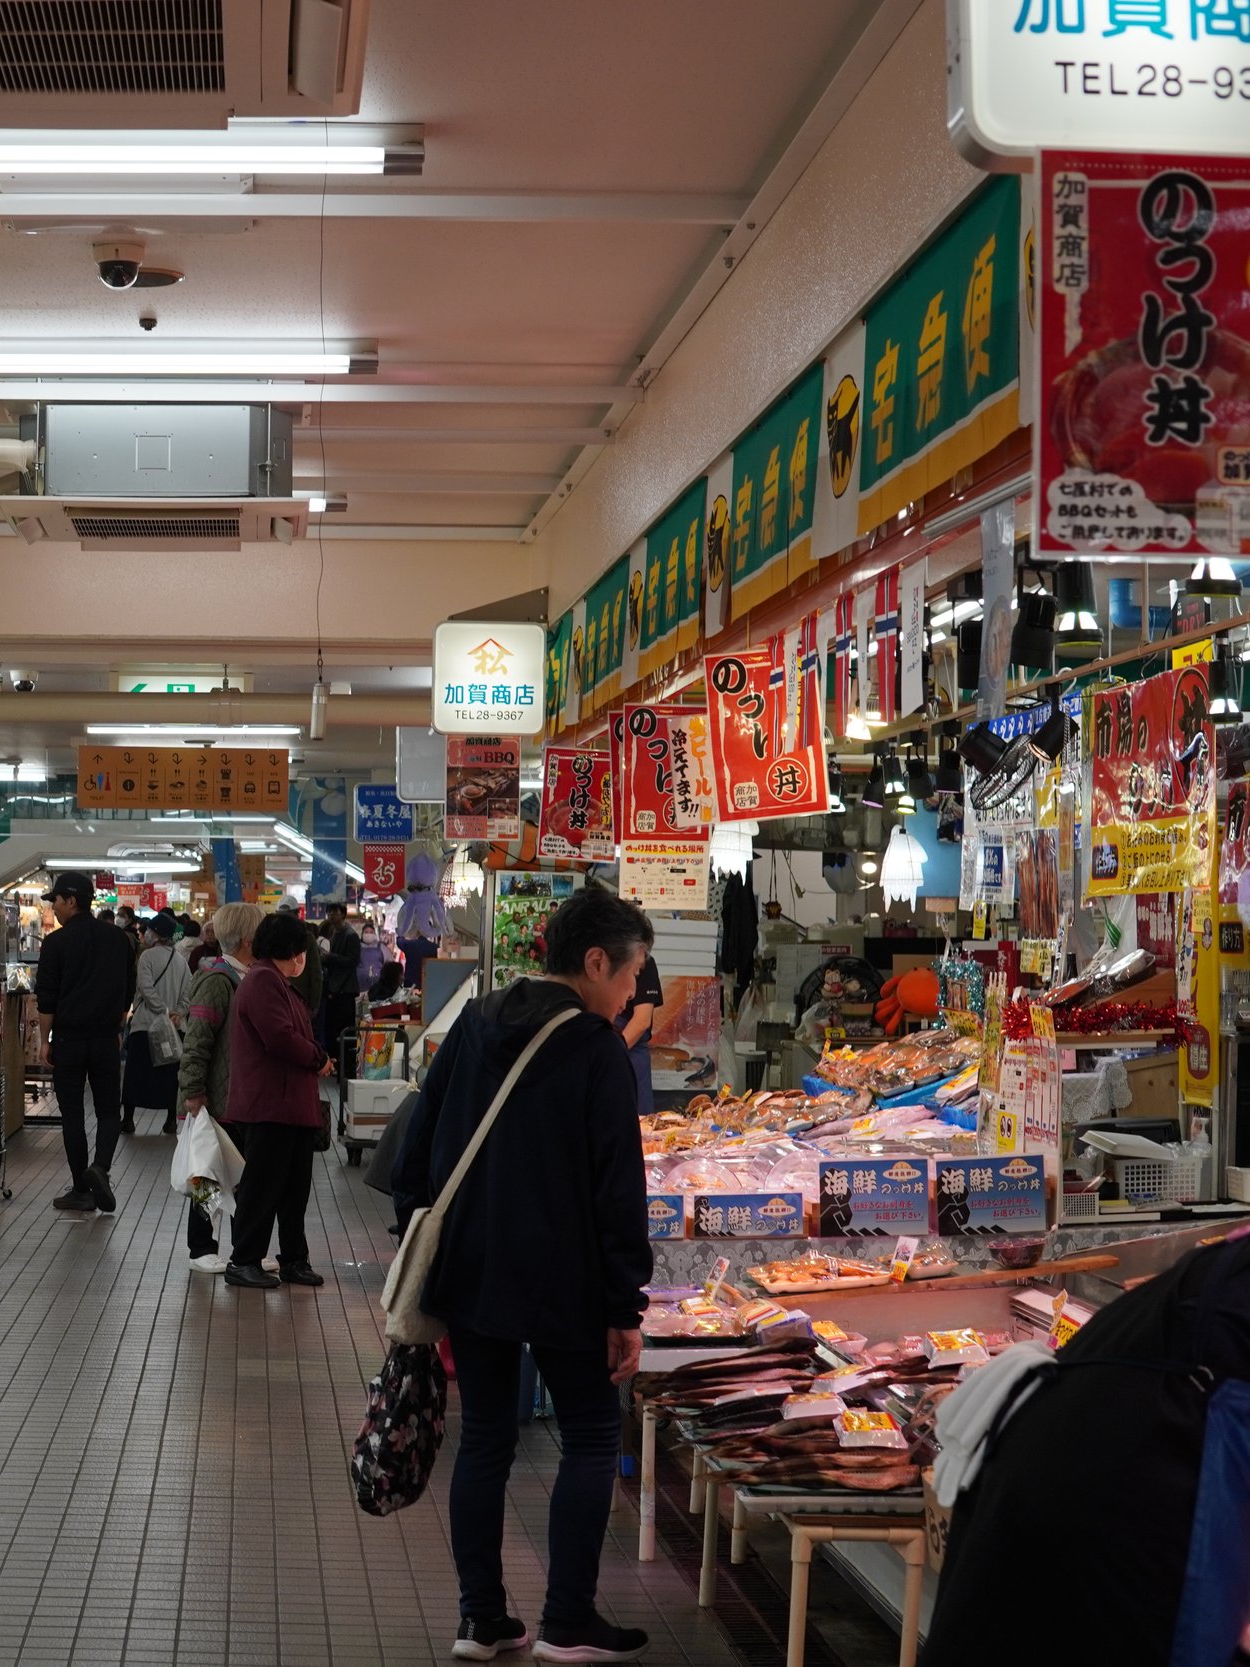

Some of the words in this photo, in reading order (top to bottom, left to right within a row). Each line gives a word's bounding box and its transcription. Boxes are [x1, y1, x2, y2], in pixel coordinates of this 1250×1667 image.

[1054, 174, 1087, 288] 加賀商店
[1140, 171, 1216, 444] のっけ丼
[872, 234, 996, 464] 宅急便
[734, 417, 811, 571] 宅急便
[647, 517, 699, 636] 宅急便
[474, 650, 509, 676] 松
[444, 683, 535, 706] 加賀商店
[484, 751, 515, 764] BBQ
[689, 716, 713, 797] 生ビール
[569, 754, 593, 830] のっけ丼
[359, 804, 412, 819] 春夏冬屋
[825, 1169, 878, 1195] 海鮮
[881, 1182, 925, 1195] のっけ丼
[942, 1167, 995, 1195] 海鮮
[998, 1179, 1040, 1192] のっけ丼
[700, 1206, 752, 1232] 海鮮
[755, 1220, 799, 1232] のっけ丼
